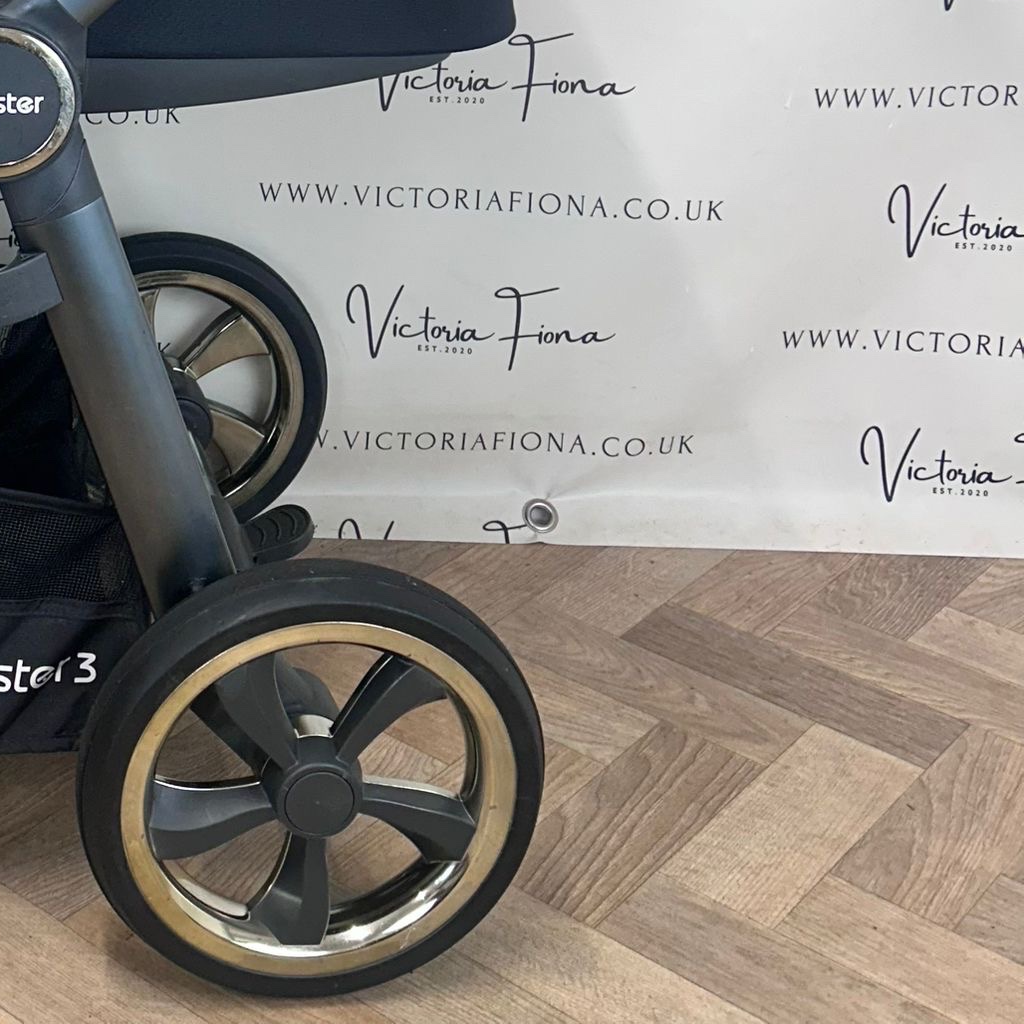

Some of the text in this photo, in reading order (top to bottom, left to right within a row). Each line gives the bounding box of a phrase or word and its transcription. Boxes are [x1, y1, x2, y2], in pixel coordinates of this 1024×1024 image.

[508, 32, 636, 122] Fiona
[428, 95, 486, 105] EST.2020
[259, 182, 723, 221] WWW.VICTORIAFIONA.CO.UK
[887, 183, 1024, 258] Victoria
[954, 241, 1014, 252] EST.2020
[345, 283, 616, 371] Victoria Fiona
[416, 344, 474, 355] EST.2020
[860, 425, 1013, 503] Victoria
[931, 487, 990, 497] EST.2020
